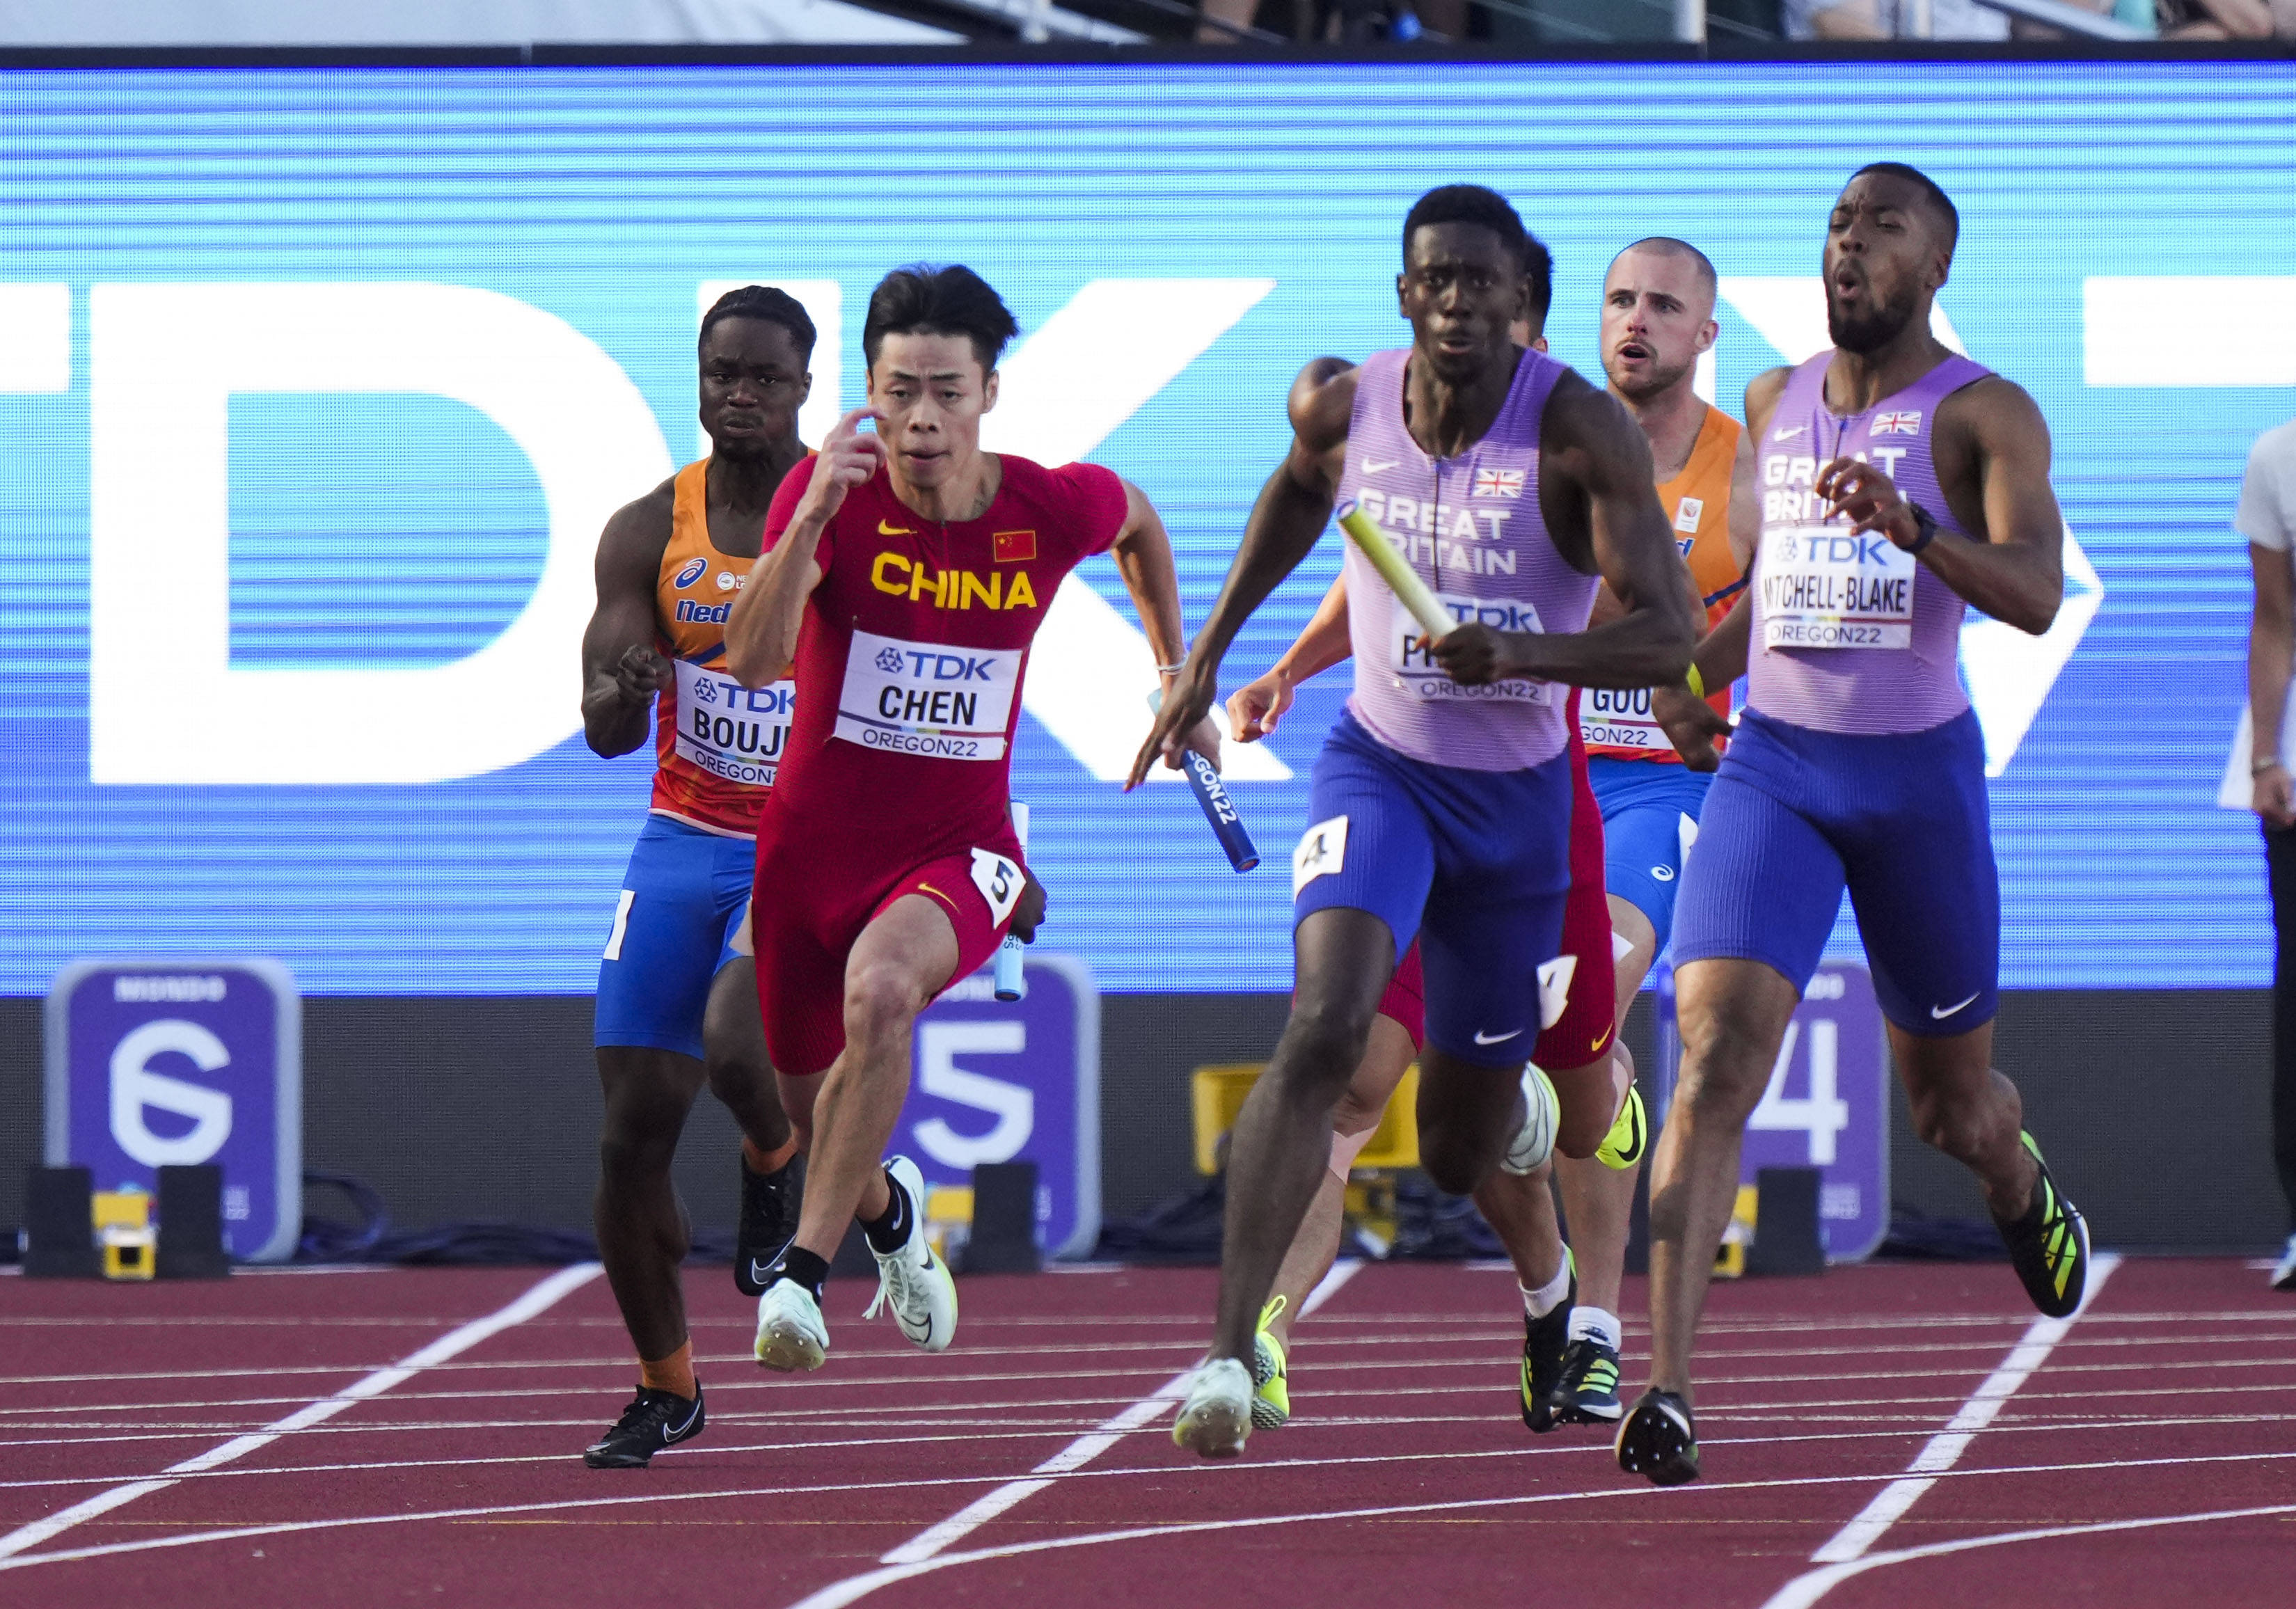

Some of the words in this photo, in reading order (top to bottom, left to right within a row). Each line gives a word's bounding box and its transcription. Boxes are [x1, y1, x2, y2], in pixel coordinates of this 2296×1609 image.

[1765, 447, 1907, 486] GRT
[0, 279, 1296, 782] DK
[1358, 487, 1512, 540] GREAT
[1381, 530, 1517, 576] RITAIN
[1804, 537, 1889, 566] TDK
[871, 552, 1037, 610] CHINA
[1771, 625, 1882, 643] OREGON22
[905, 651, 997, 681] TDK
[879, 685, 978, 726] CHEN
[863, 729, 979, 757] OREGON22
[1581, 726, 1648, 745] GON22
[695, 751, 777, 784] OREGON
[1188, 750, 1237, 825] GON22
[991, 859, 1014, 904] 5
[109, 1019, 233, 1168] 6
[912, 1020, 1035, 1170] 5
[1747, 1019, 1849, 1166] 4
